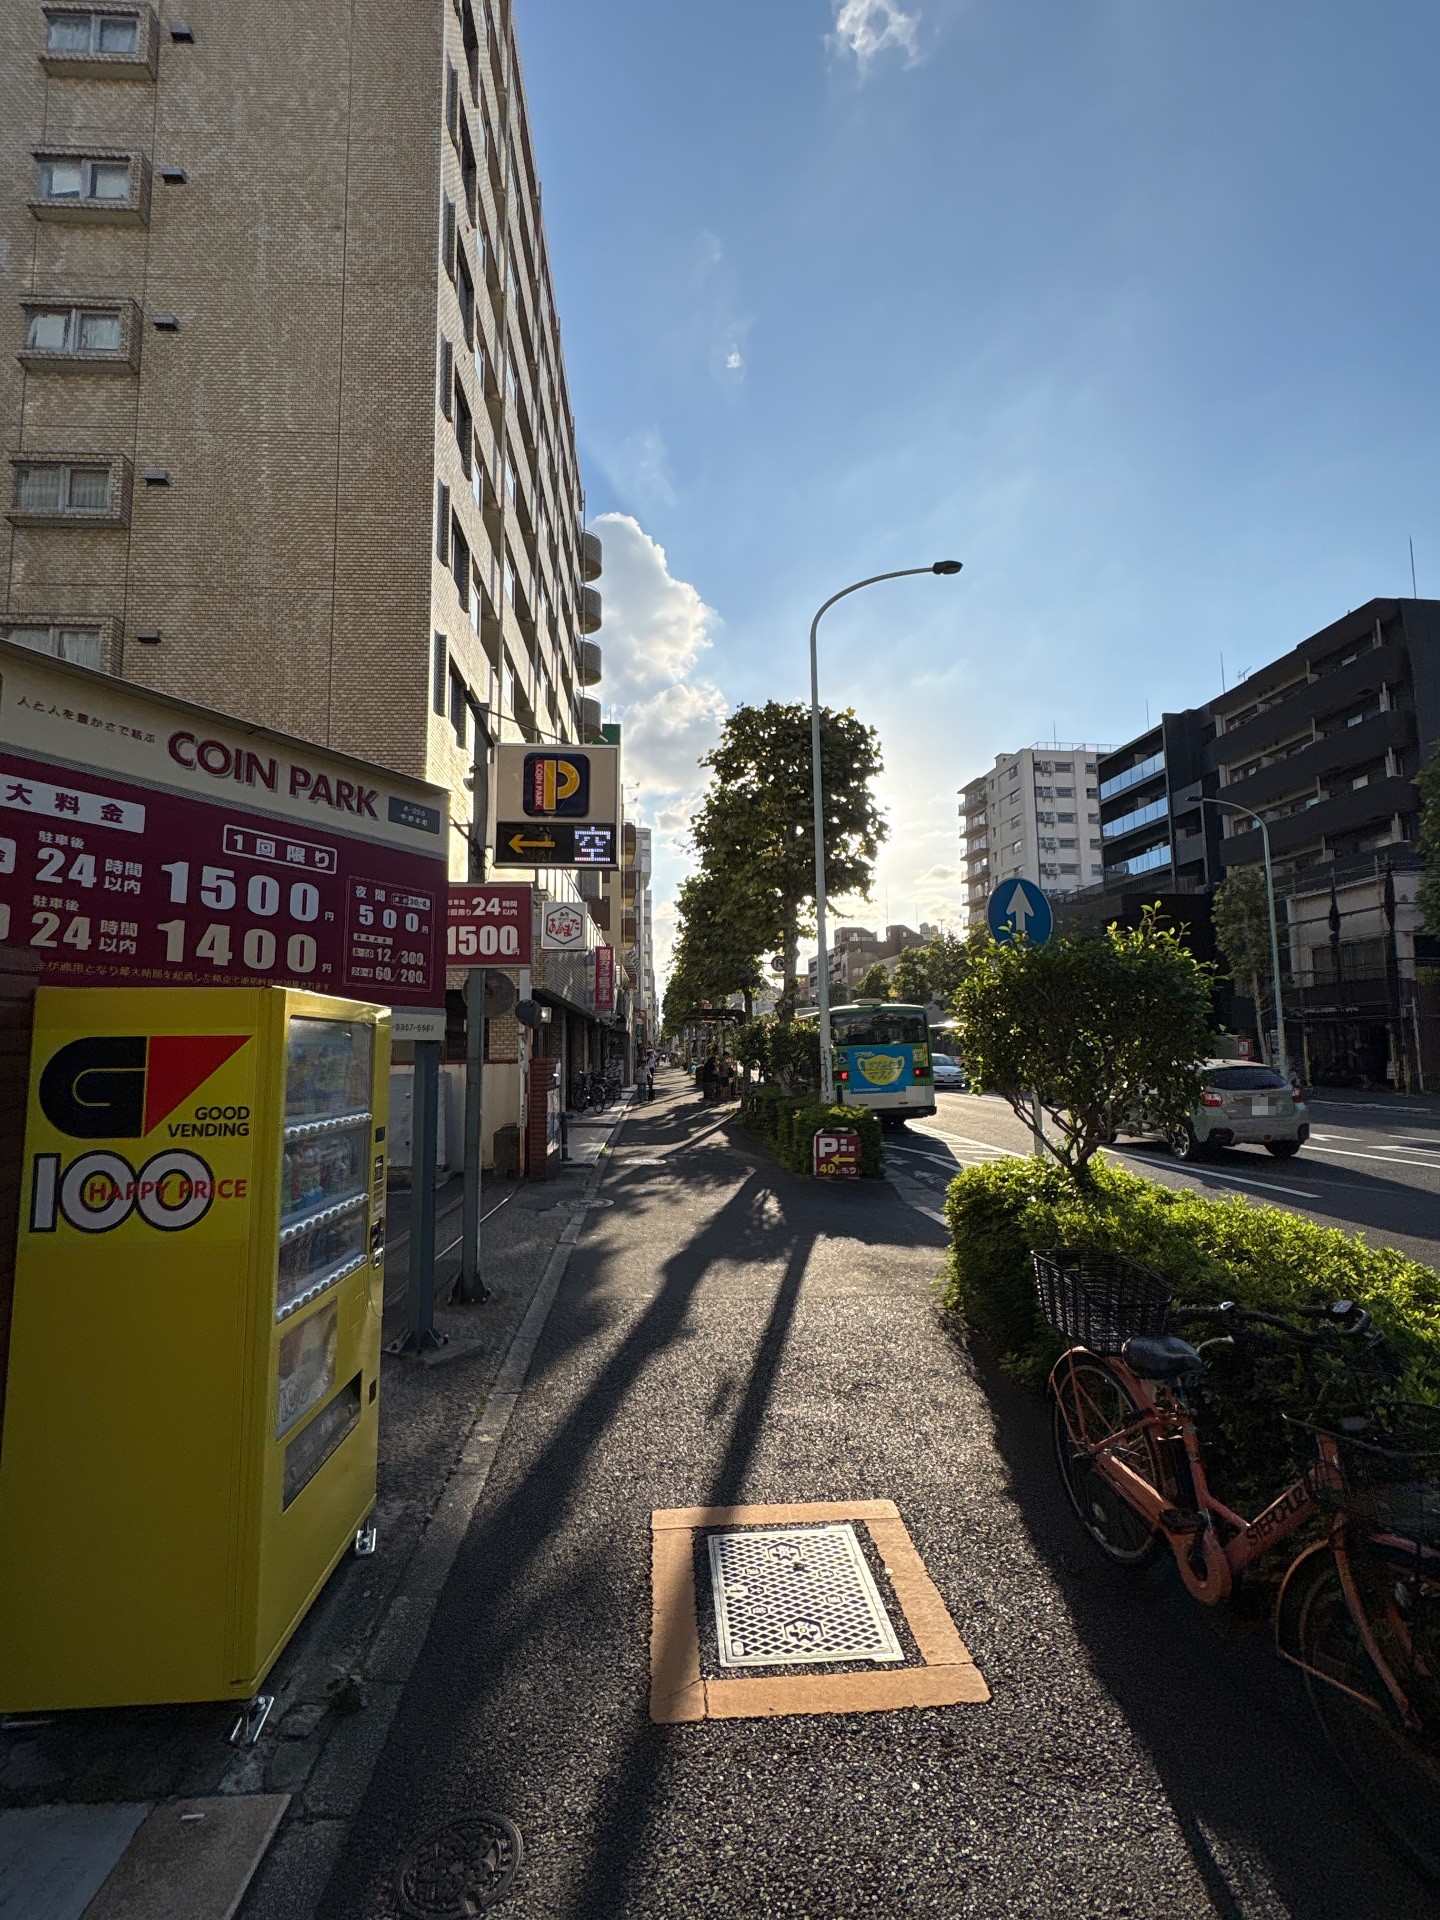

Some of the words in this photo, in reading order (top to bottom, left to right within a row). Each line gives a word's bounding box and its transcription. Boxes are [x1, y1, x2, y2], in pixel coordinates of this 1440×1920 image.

[168, 731, 277, 791] COIN
[289, 765, 378, 819] PARK
[535, 764, 544, 783] COIN
[6, 783, 124, 824] 大料金
[535, 785, 543, 809] PARK
[38, 830, 85, 849] 駐車後
[574, 826, 611, 862] 空
[234, 834, 330, 868] 1回限り
[36, 848, 97, 888] 24
[104, 858, 143, 878] 時間
[103, 875, 141, 895] 以内
[355, 885, 386, 902] 夜間
[33, 895, 80, 912] 駐車後
[471, 897, 502, 916] 24
[502, 900, 518, 908] 時間
[502, 908, 518, 916] 以内
[30, 911, 92, 950] 24
[100, 919, 139, 938] 時間
[99, 936, 137, 954] 以内
[194, 1106, 251, 1121] GOOD
[168, 1122, 251, 1138] VENDING
[818, 1137, 839, 1158] P
[819, 1163, 836, 1174] 40
[29, 1148, 216, 1234] 100
[89, 1181, 172, 1202] HAPPY
[179, 1179, 248, 1199] PRICE
